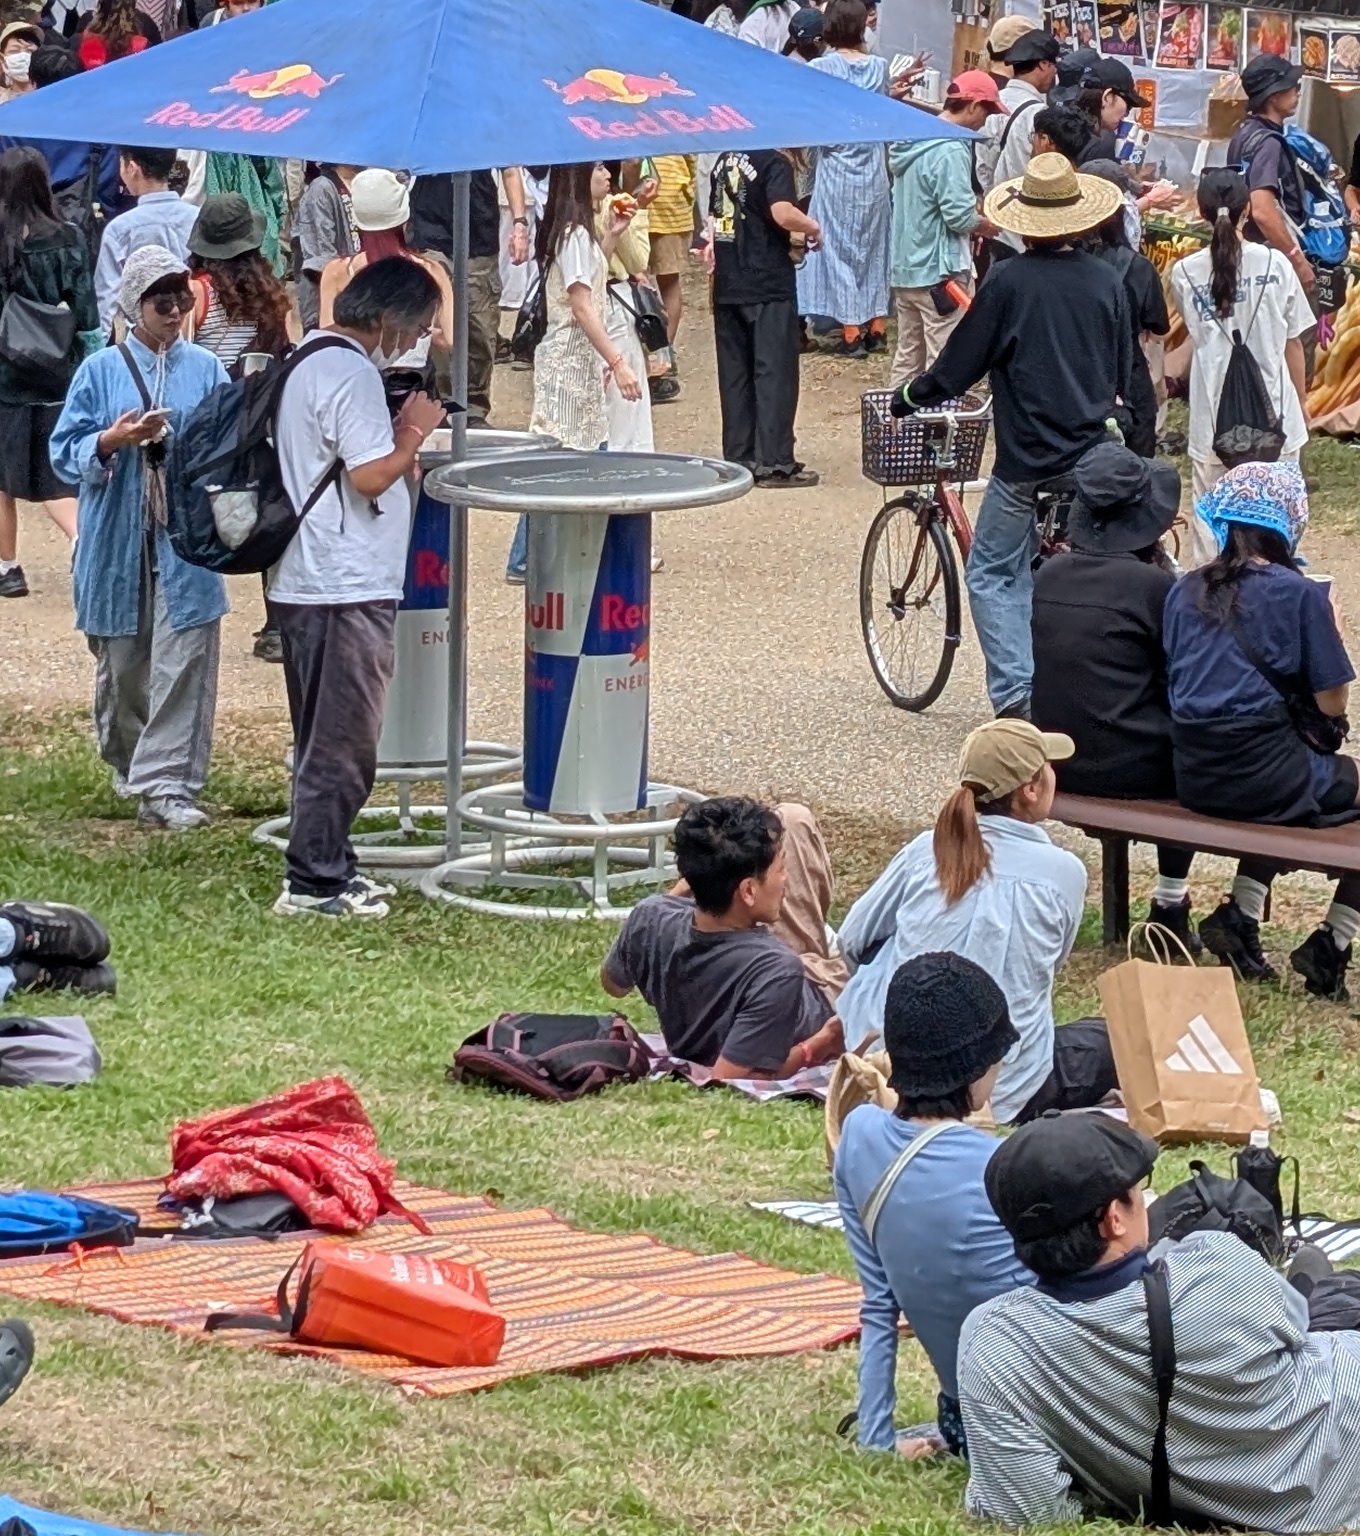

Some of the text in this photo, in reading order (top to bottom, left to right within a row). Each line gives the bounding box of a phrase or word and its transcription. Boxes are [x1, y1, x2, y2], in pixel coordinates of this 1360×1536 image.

[143, 100, 312, 134] Red Bull
[567, 104, 757, 140] Red Bull
[526, 591, 564, 631] ull
